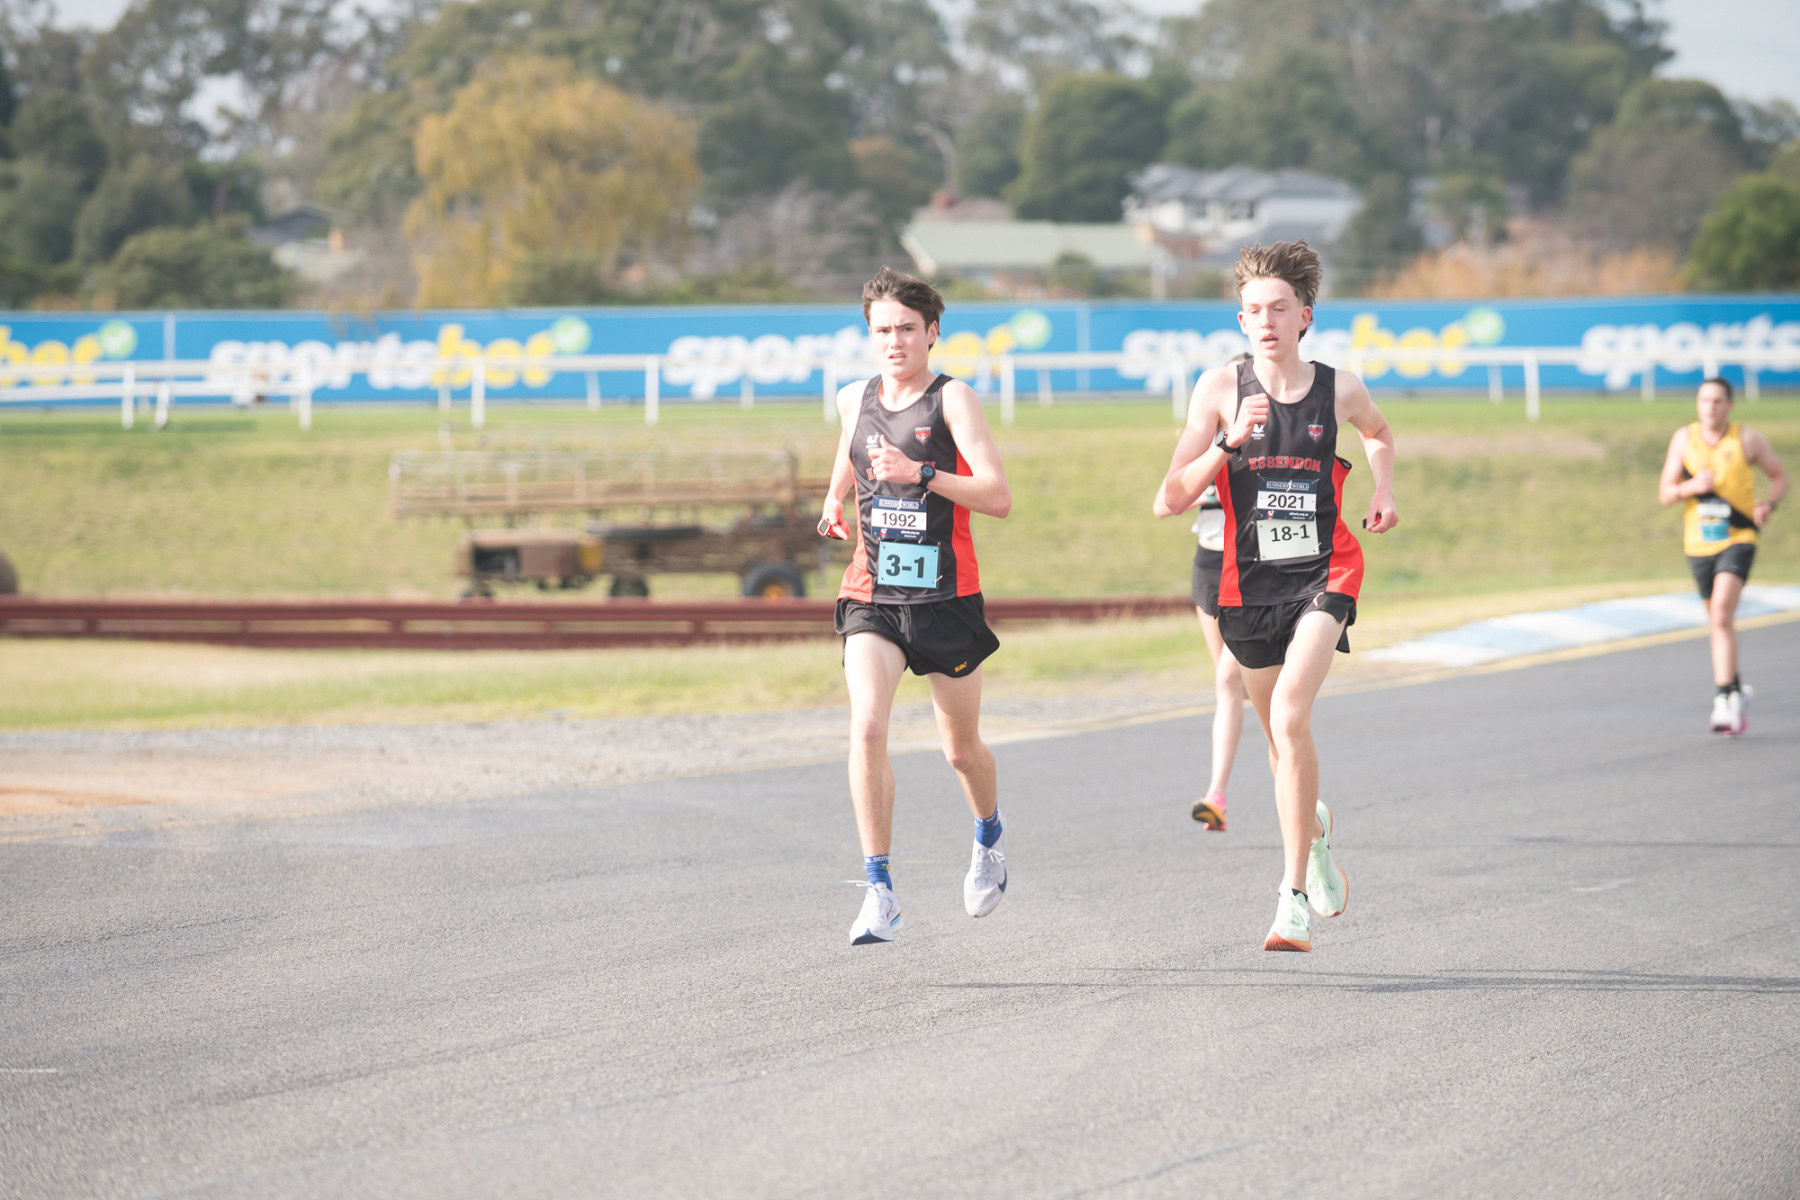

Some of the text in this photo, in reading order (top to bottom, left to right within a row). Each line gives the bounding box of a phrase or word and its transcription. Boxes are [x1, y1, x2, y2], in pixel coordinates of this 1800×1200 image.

[1248, 456, 1321, 472] ESSENDON
[1267, 493, 1305, 509] 2021
[882, 512, 917, 528] 1992
[1270, 523, 1310, 542] 18-1
[885, 554, 925, 579] 3-1
